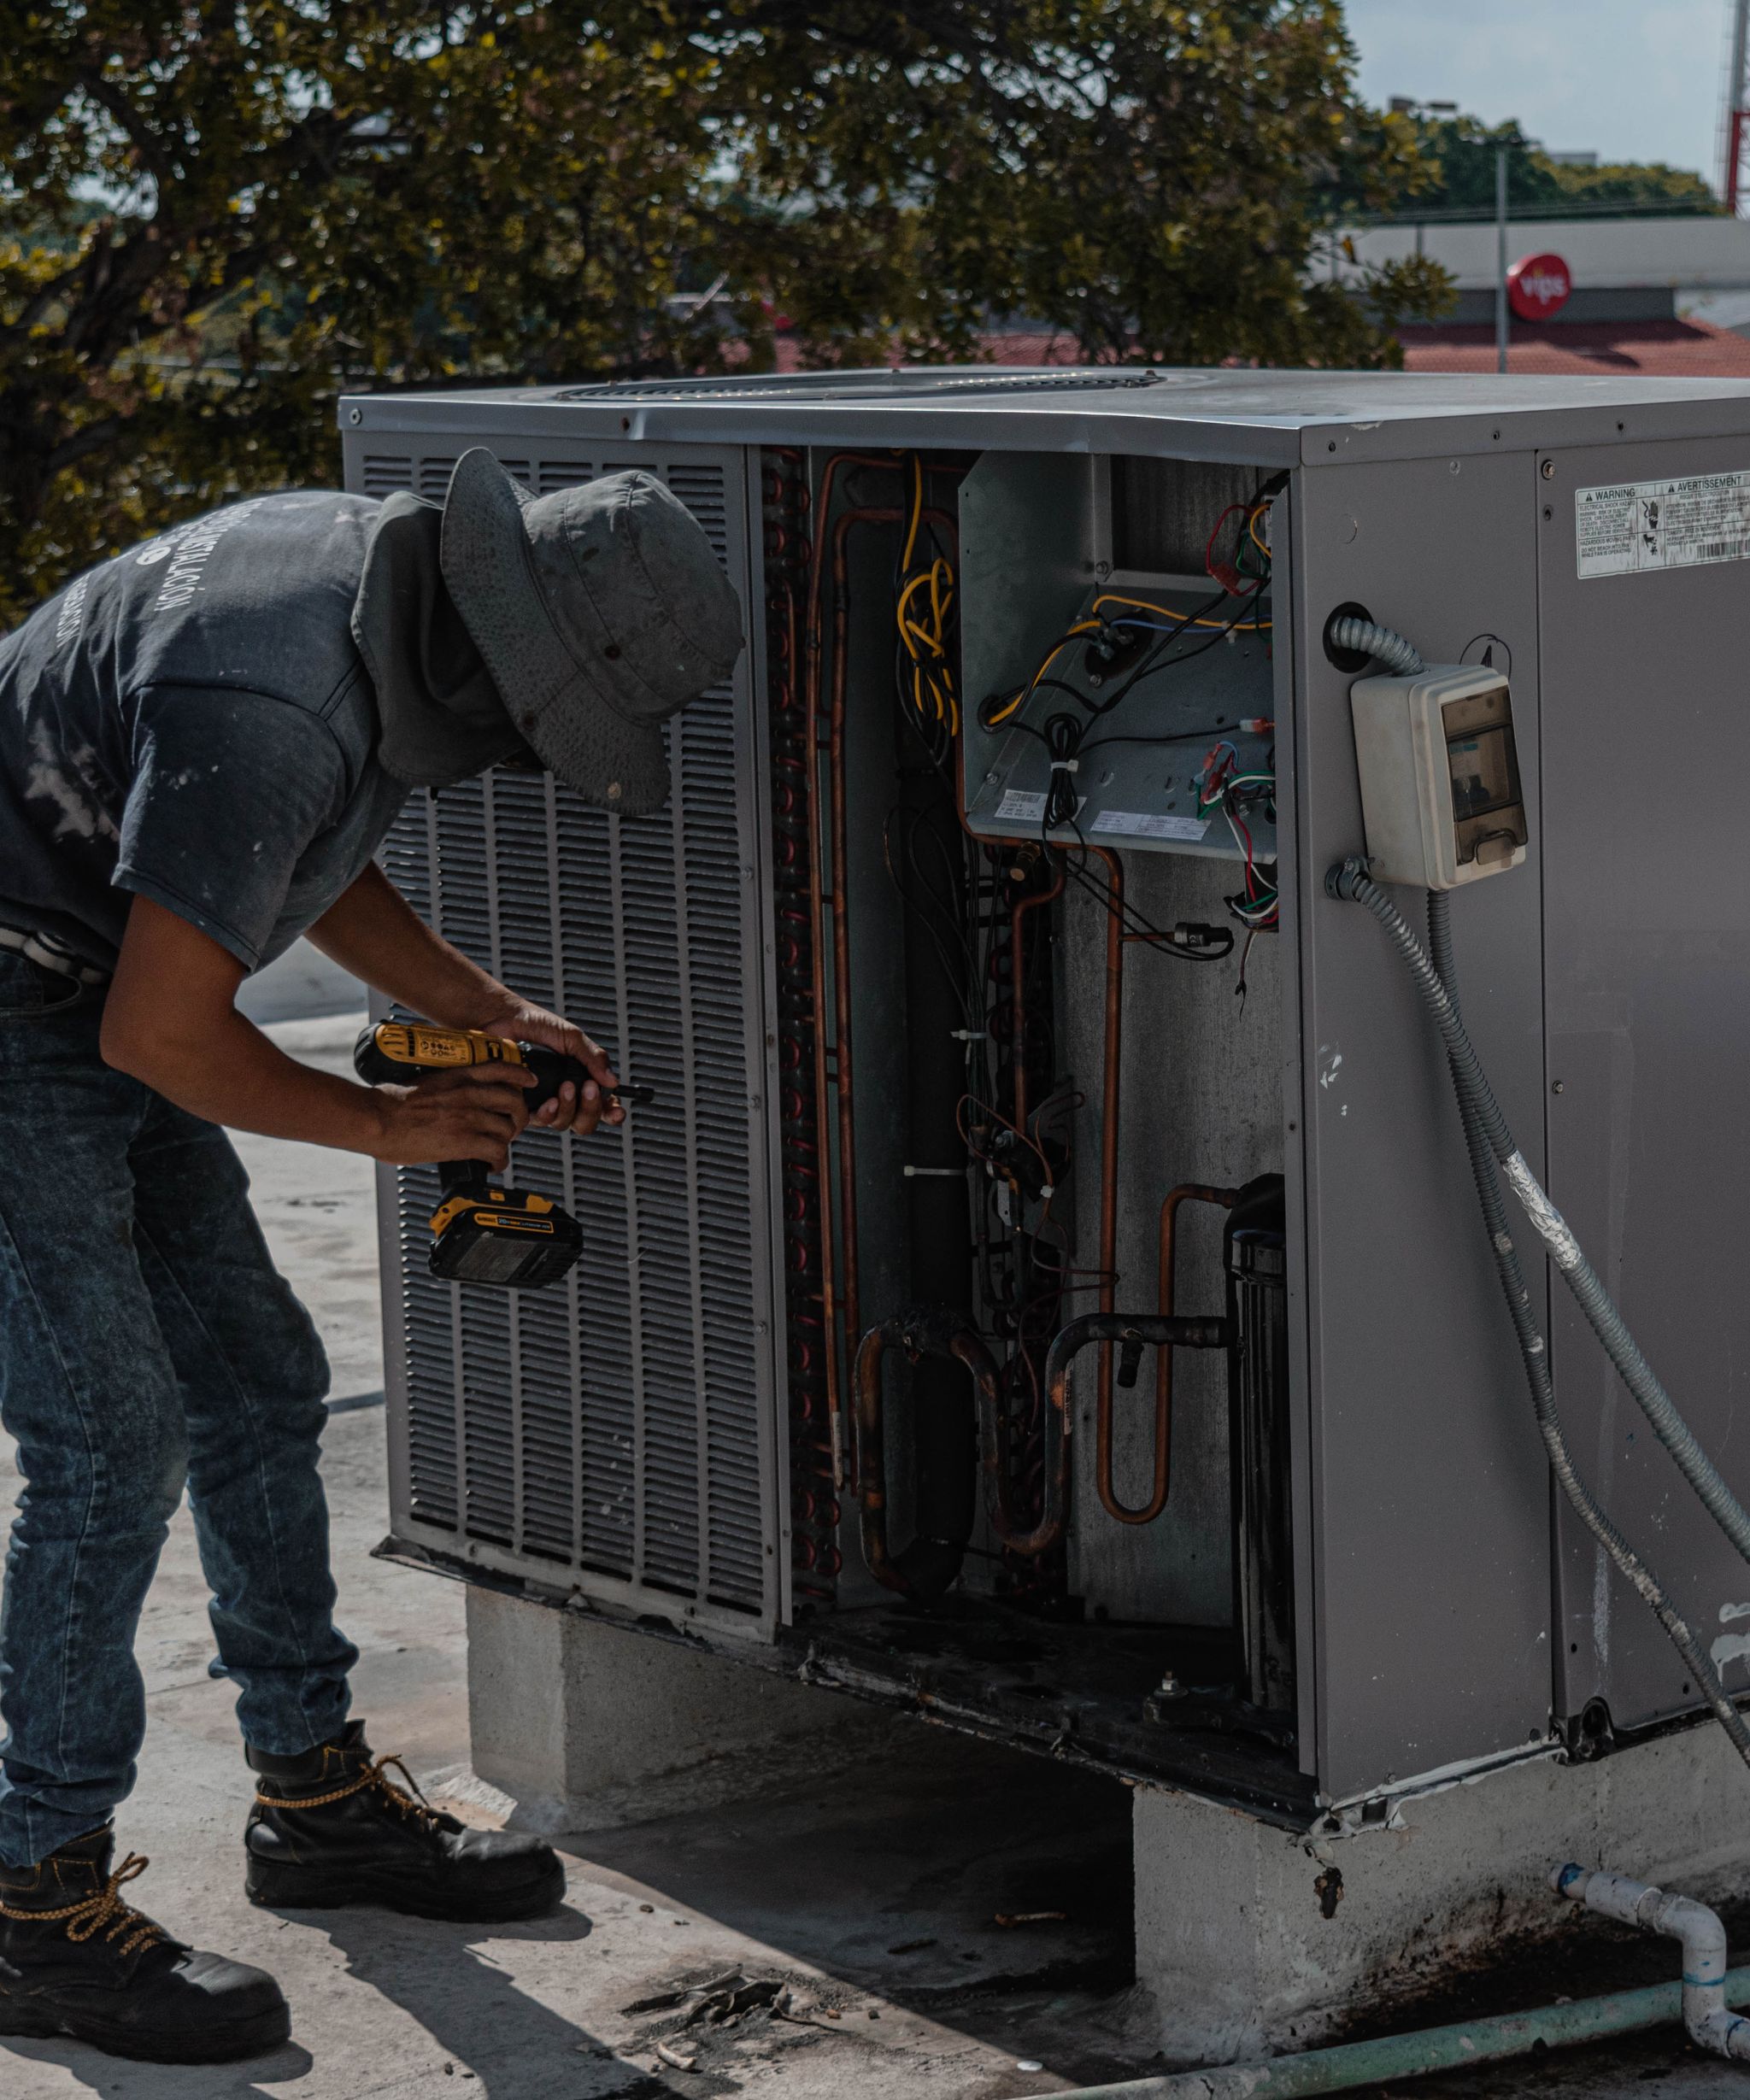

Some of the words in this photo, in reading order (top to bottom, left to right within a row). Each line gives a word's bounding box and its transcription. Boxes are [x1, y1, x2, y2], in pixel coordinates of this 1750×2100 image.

[1518, 268, 1566, 305] vips
[1677, 476, 1741, 492] AVERTISSEMENT
[1595, 488, 1635, 501] WARNING
